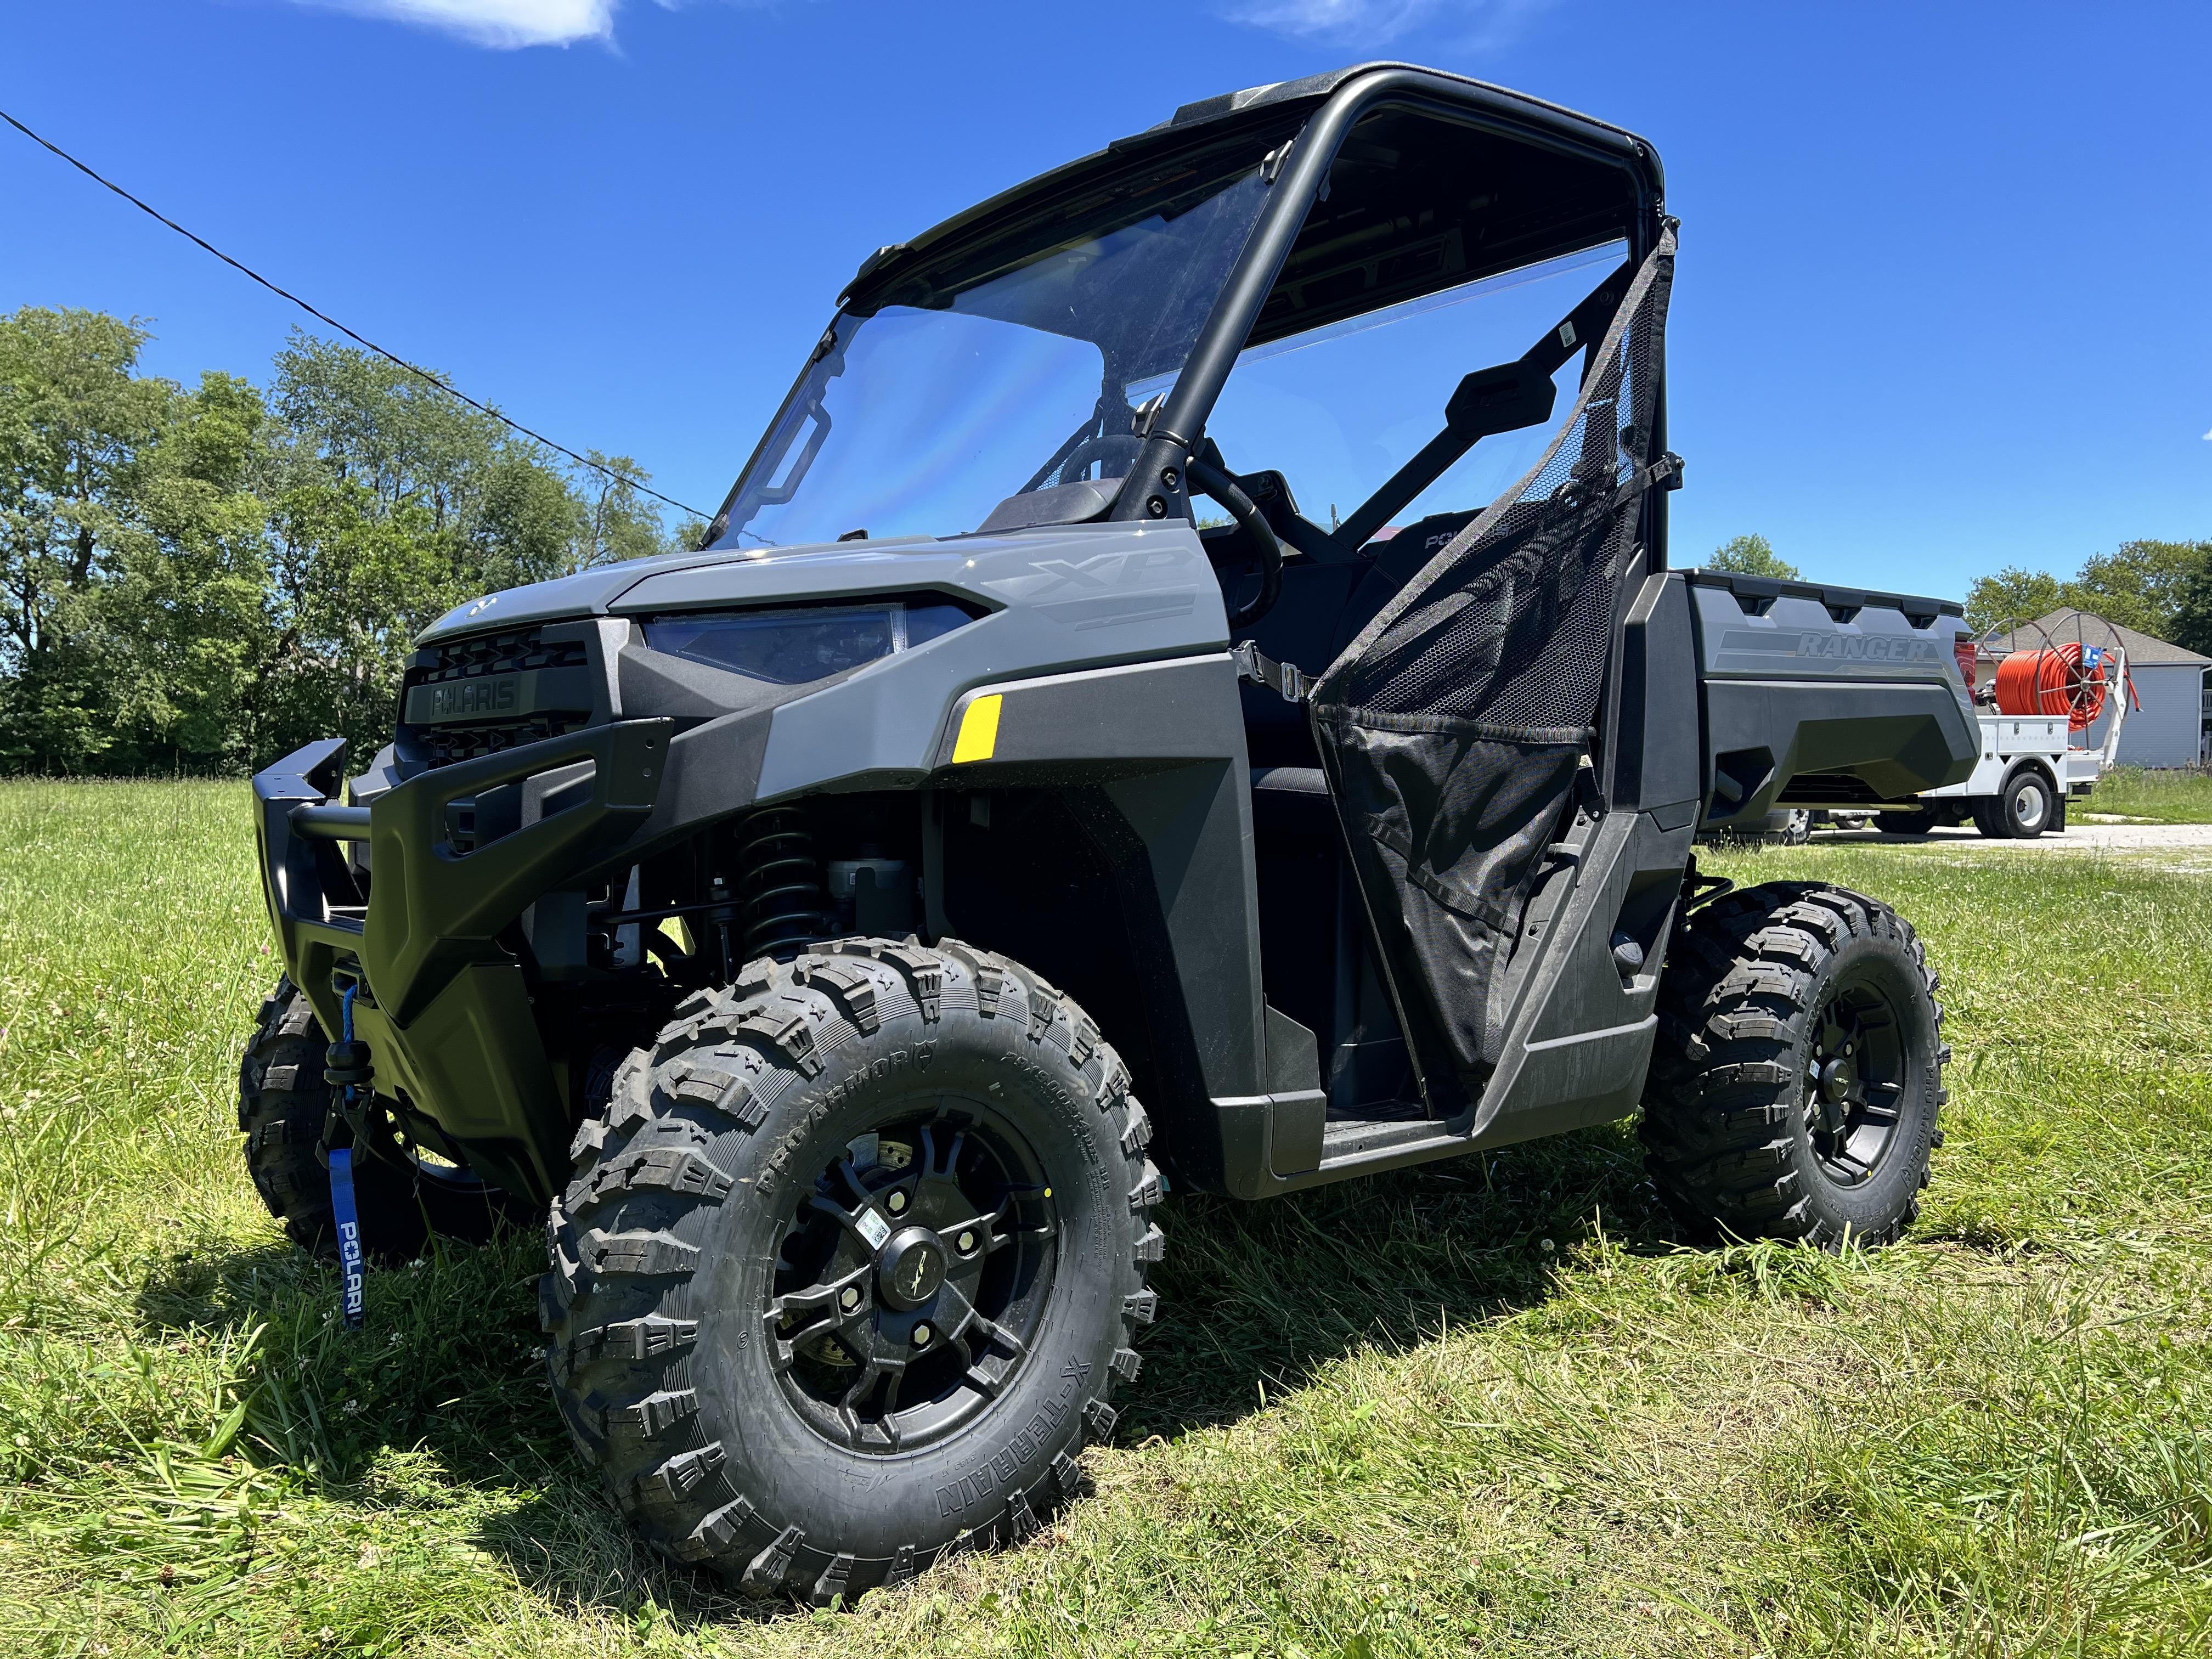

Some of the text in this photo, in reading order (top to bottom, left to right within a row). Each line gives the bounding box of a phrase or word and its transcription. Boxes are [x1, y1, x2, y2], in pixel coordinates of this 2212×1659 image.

[1025, 546, 1201, 597] XP
[1795, 631, 1929, 662] RANGER
[432, 680, 514, 716] POLARIS
[755, 1050, 908, 1199] PRO ARMOR
[935, 1352, 1092, 1518] X-TERRAIN
